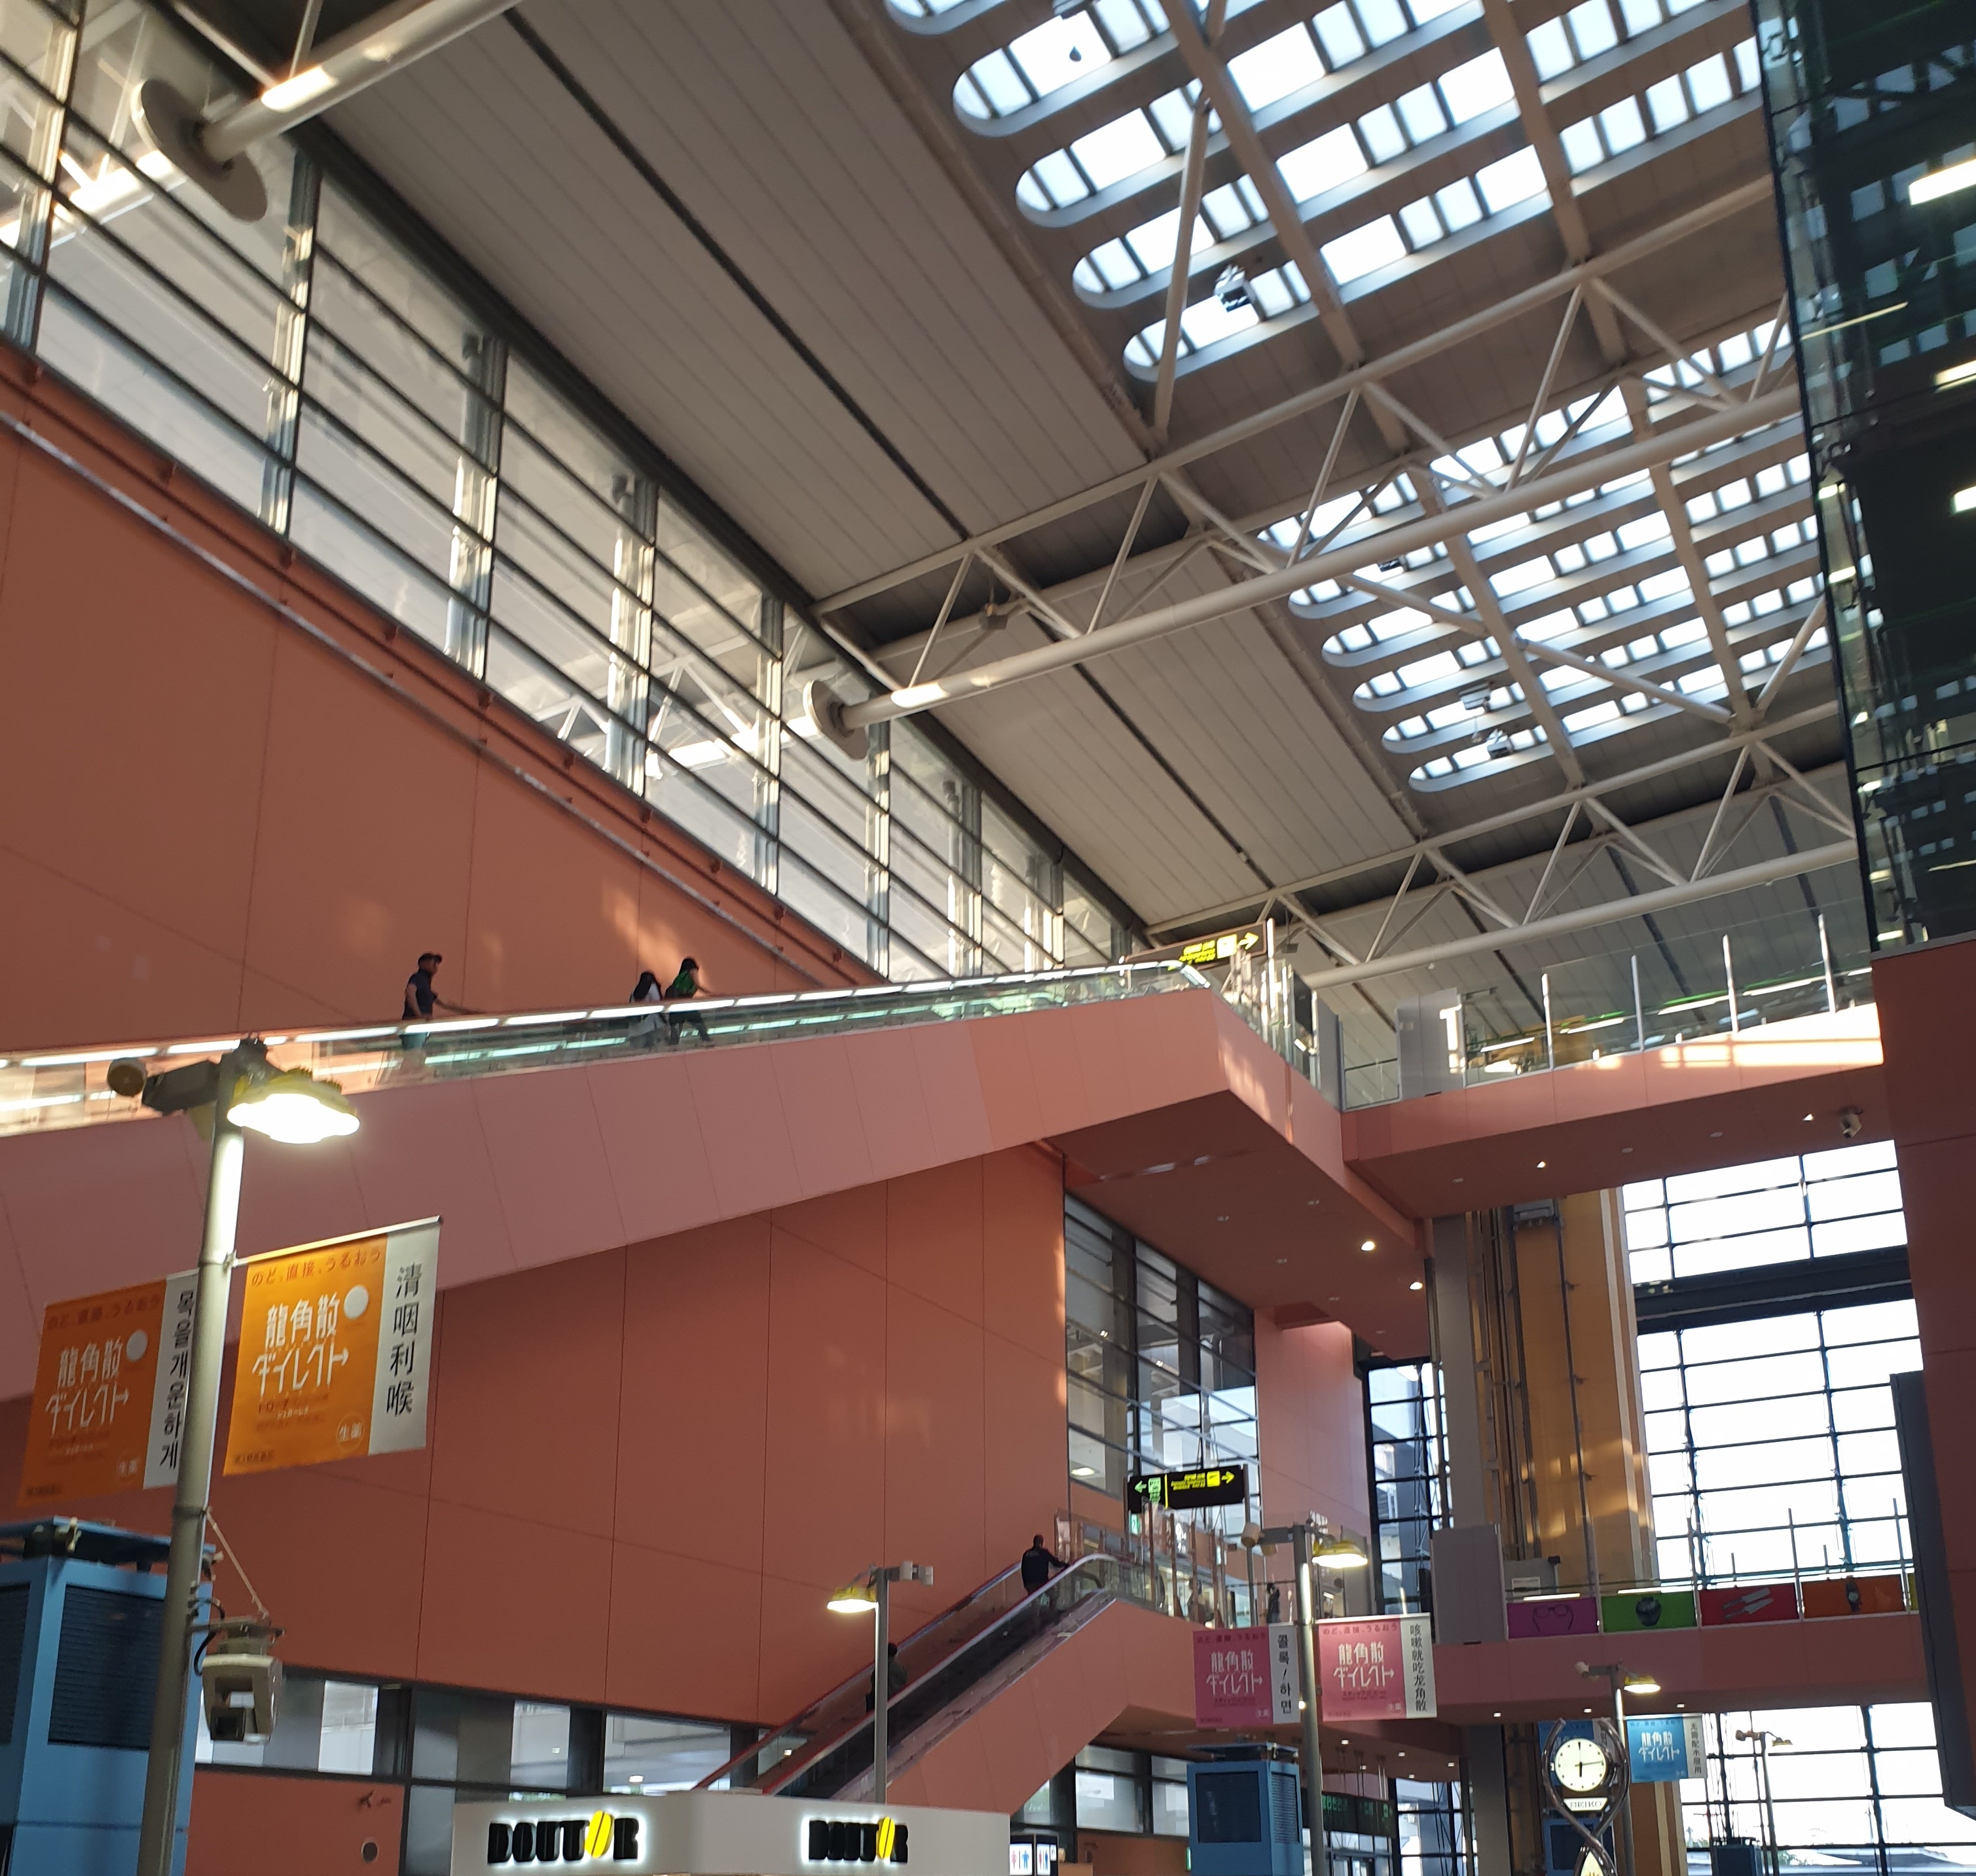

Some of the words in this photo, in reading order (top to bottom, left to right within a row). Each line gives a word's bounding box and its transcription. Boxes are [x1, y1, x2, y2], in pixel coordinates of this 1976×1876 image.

[386, 1261, 423, 1417] 清咽利喉
[487, 1810, 640, 1864] DOUTOR
